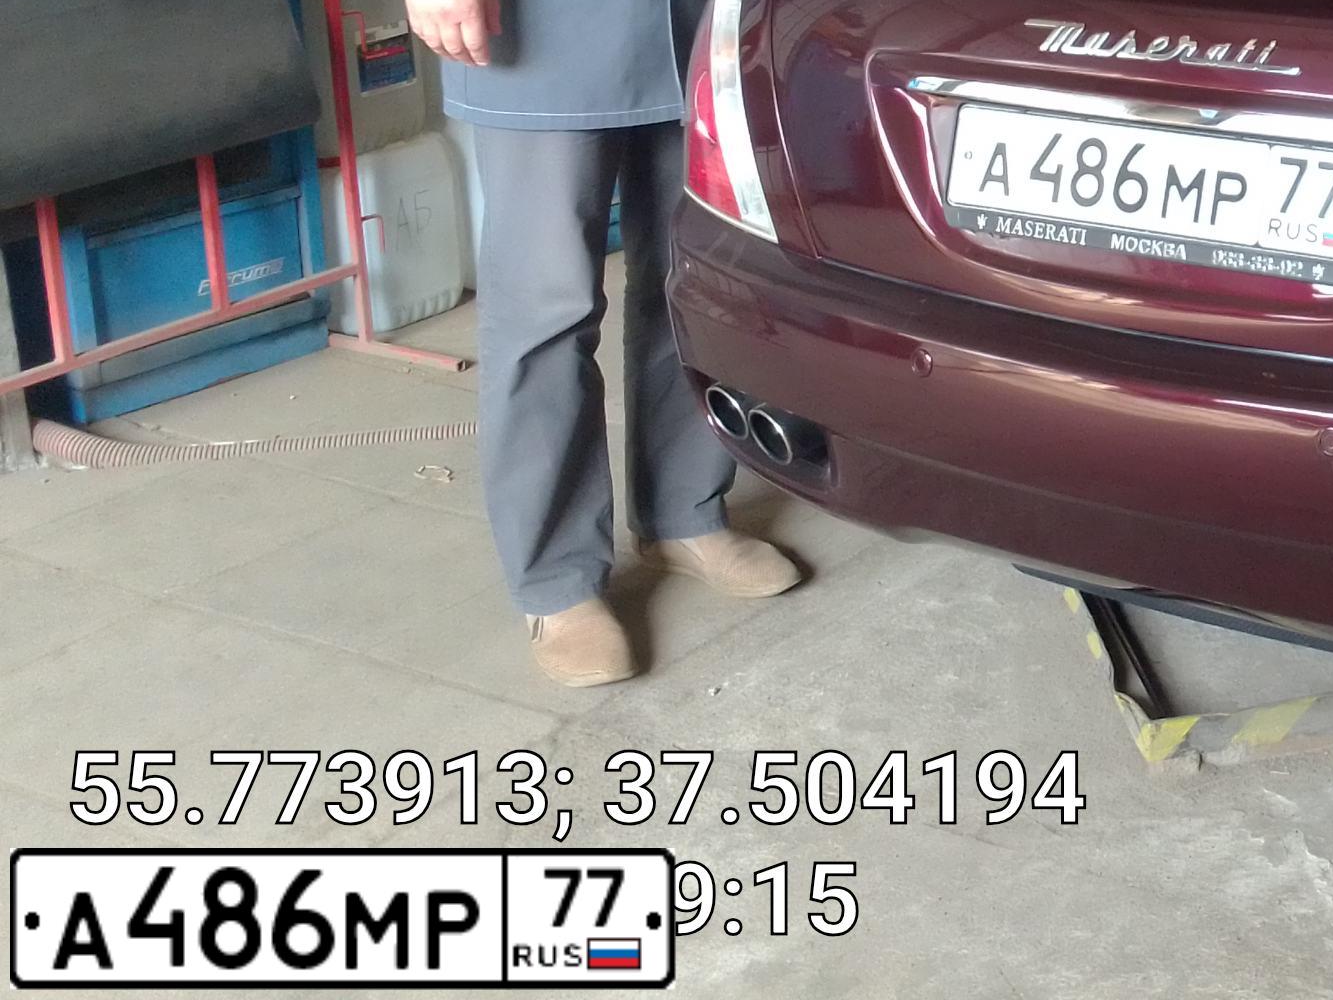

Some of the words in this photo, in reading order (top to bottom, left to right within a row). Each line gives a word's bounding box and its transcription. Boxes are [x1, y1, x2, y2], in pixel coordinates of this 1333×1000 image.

[1024, 19, 1302, 75] Maserati
[995, 216, 1088, 247] MASERATI
[1110, 234, 1187, 262] МОСКВА
[1268, 217, 1319, 244] RUS
[197, 264, 273, 297] Frum
